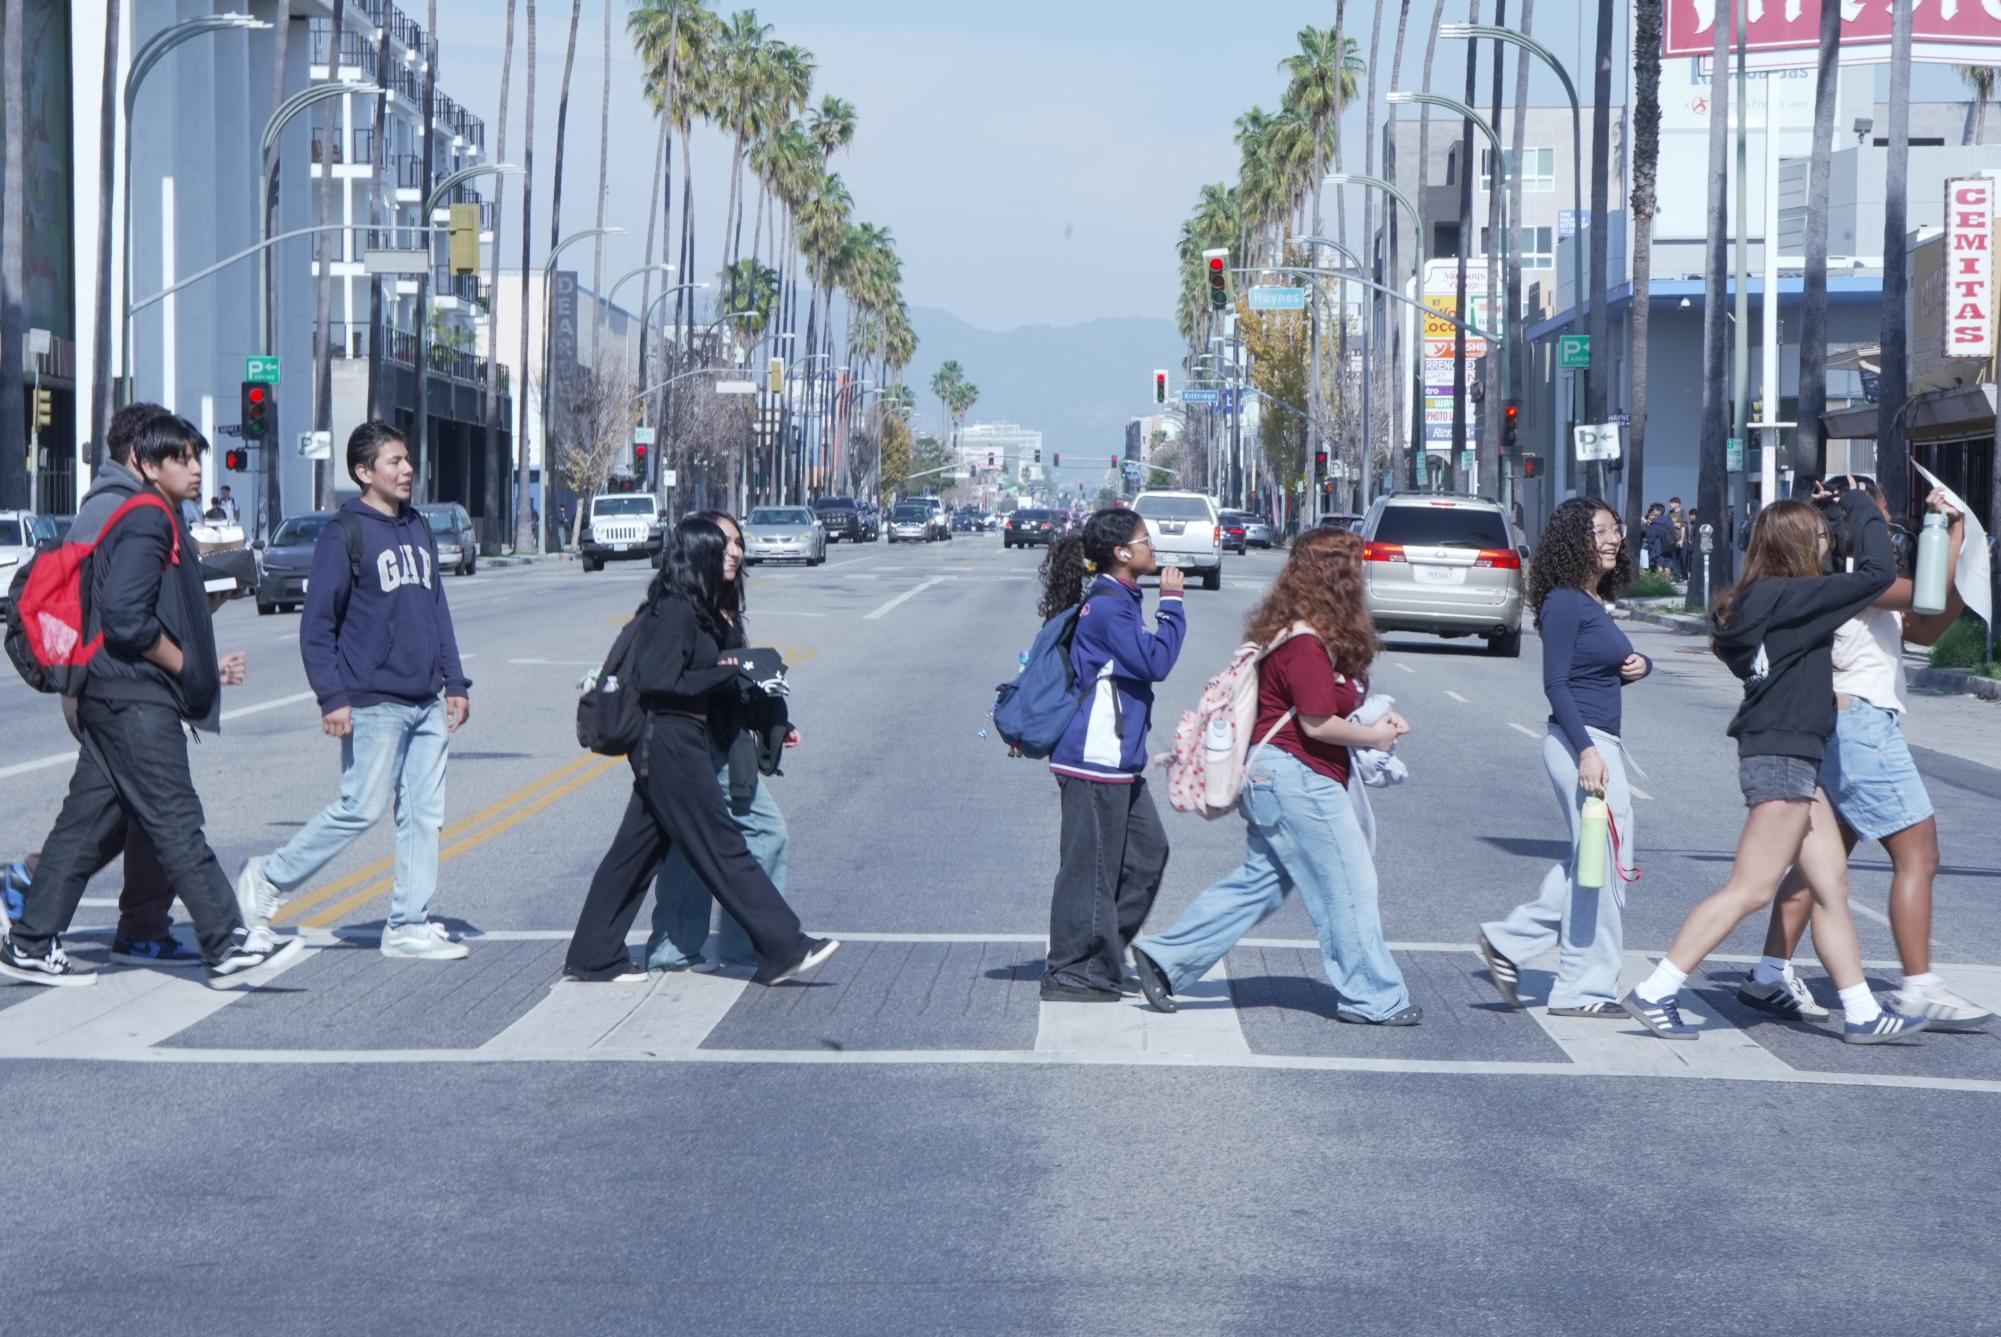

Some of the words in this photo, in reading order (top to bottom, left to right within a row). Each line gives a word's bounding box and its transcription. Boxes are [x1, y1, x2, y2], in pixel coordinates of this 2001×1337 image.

[1954, 188, 1987, 343] CEMITAS
[1254, 291, 1300, 305] Haynes
[1565, 341, 1581, 361] P
[248, 361, 263, 380] P
[1184, 392, 1216, 401] Kittridge
